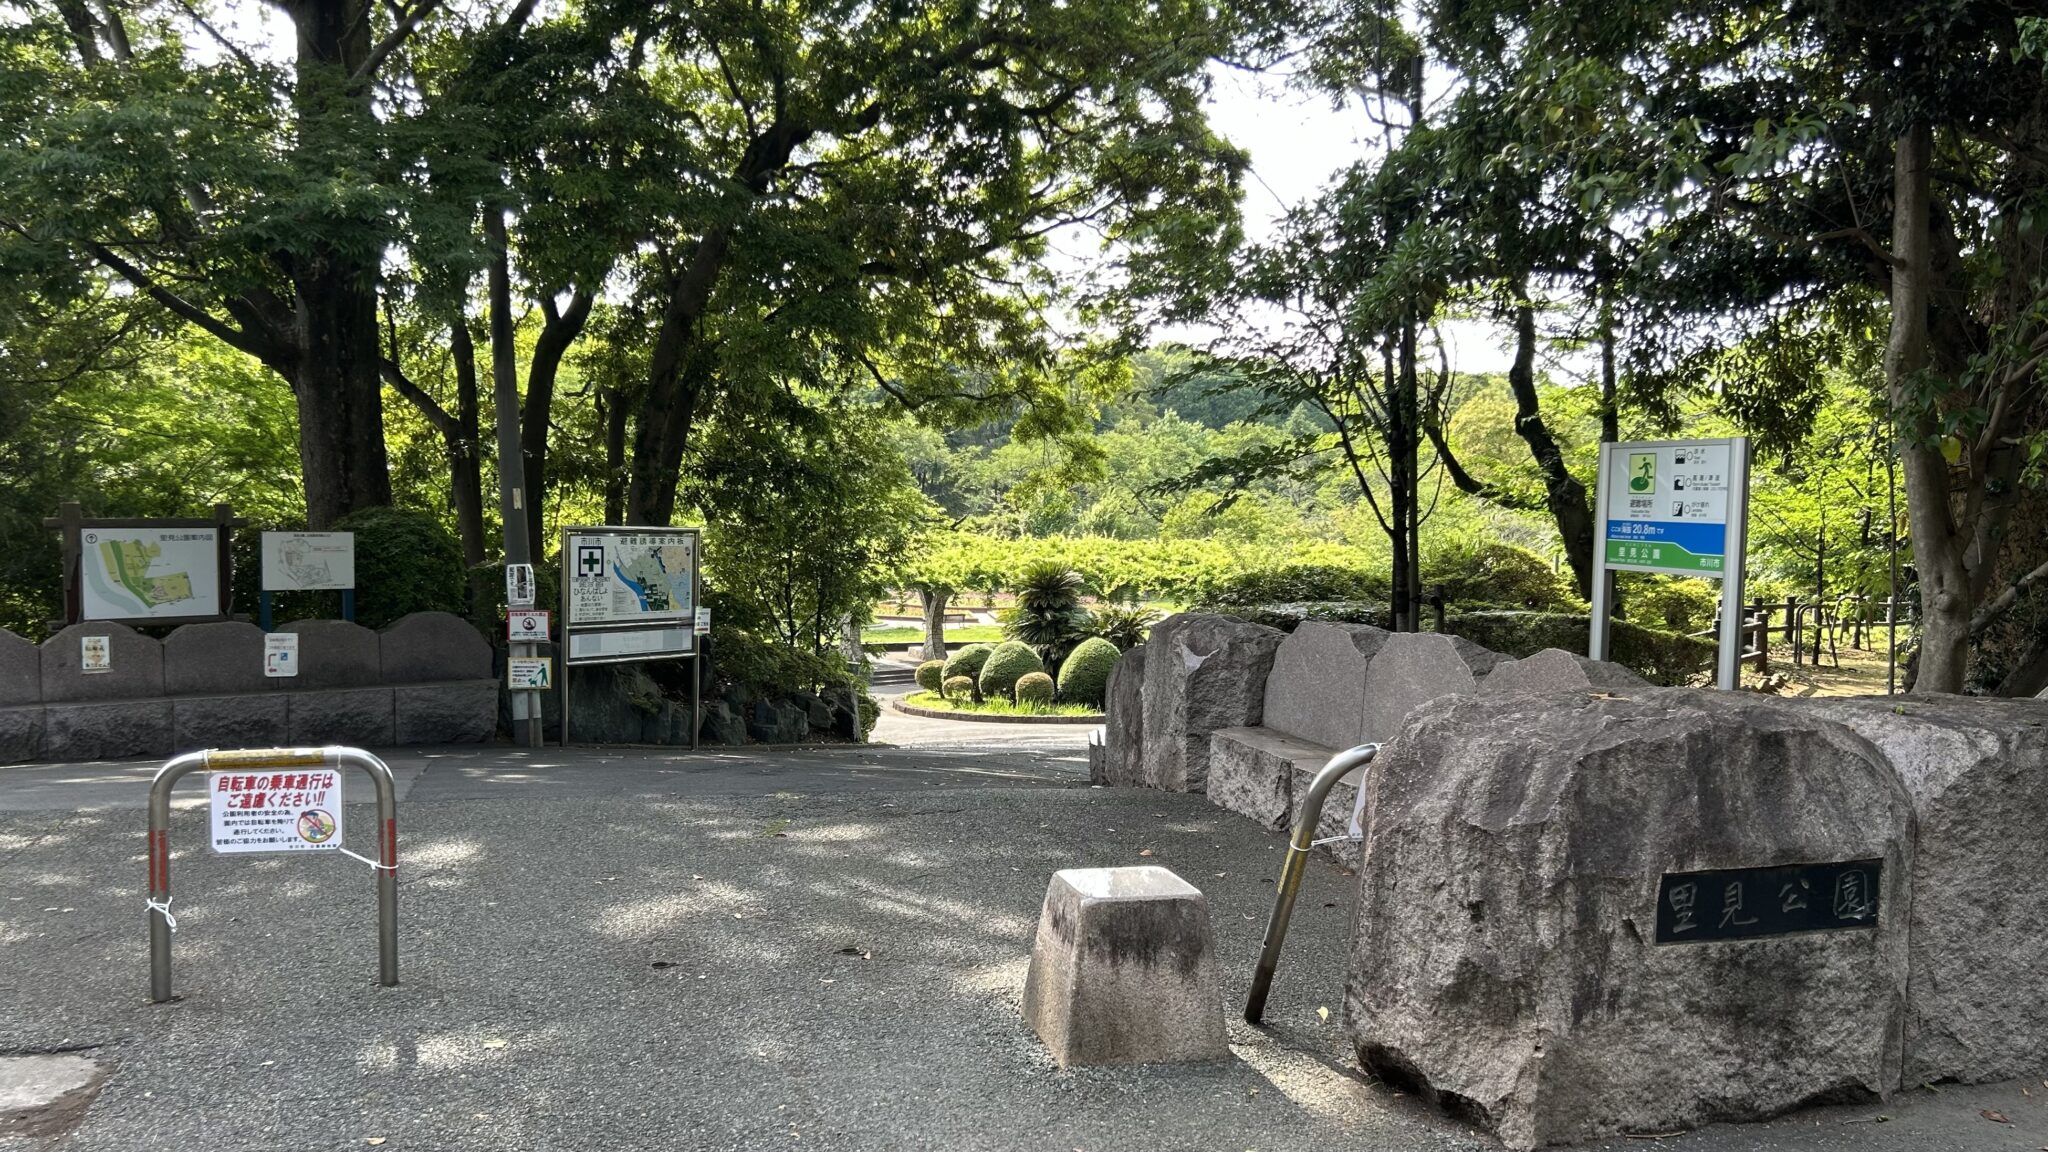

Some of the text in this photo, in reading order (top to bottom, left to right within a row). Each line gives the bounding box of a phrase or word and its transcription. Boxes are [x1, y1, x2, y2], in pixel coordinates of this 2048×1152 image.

[580, 537, 601, 545] 市川市
[620, 537, 684, 546] 避難誘導案内板
[1618, 546, 1661, 560] 里見公園
[1699, 558, 1720, 568] 市川市
[218, 773, 333, 792] 自転車の乗車通行は
[224, 818, 295, 826] 園内では自転車を降りて
[1668, 869, 1870, 935] 里見公園
